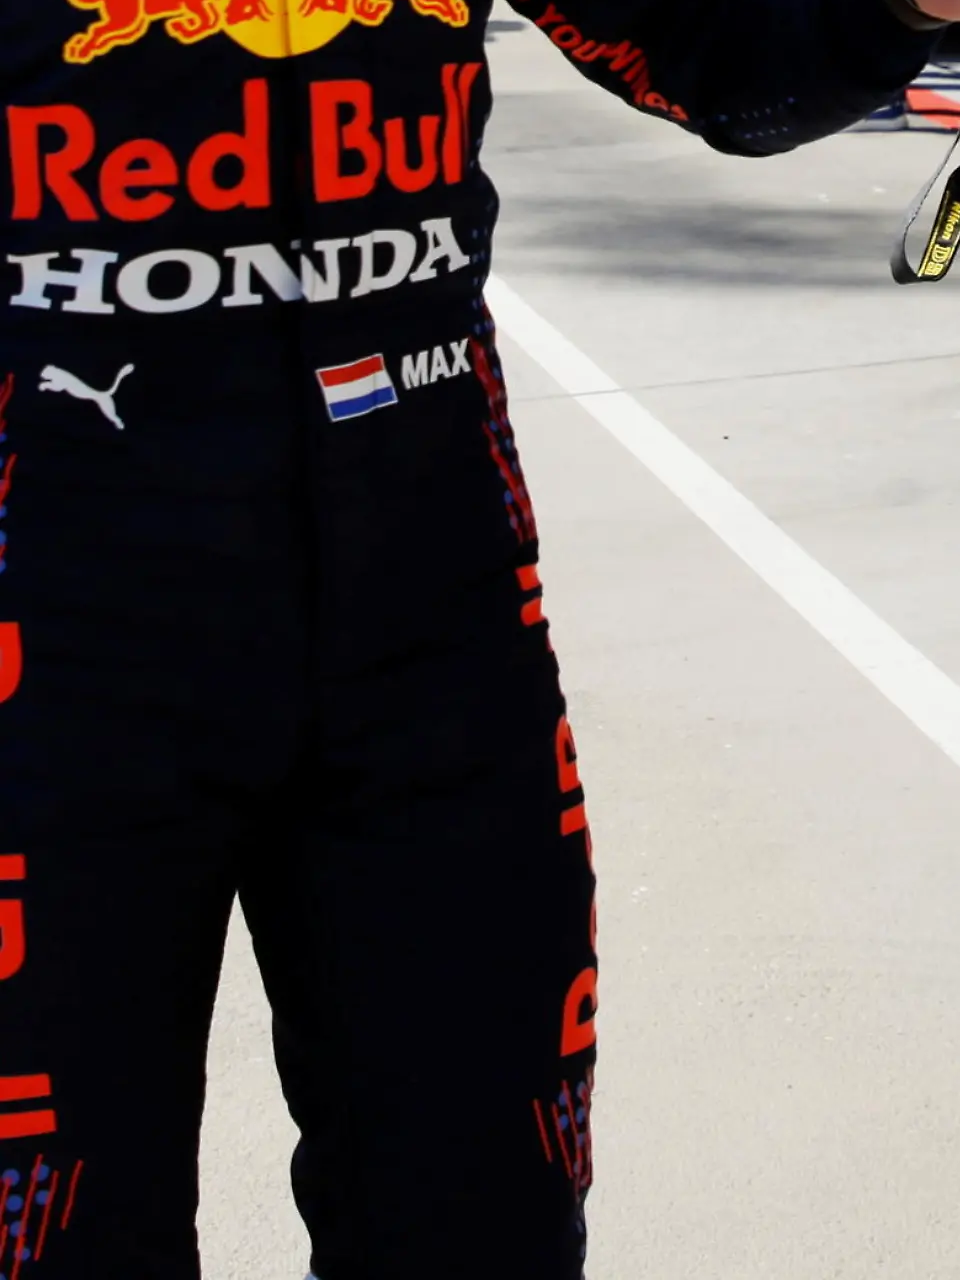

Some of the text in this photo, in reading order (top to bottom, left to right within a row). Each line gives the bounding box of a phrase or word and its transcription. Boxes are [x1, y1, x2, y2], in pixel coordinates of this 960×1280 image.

[535, 3, 603, 63] YOU
[6, 62, 483, 222] Red Bull
[6, 217, 470, 315] HONDA
[401, 338, 471, 391] MAX
